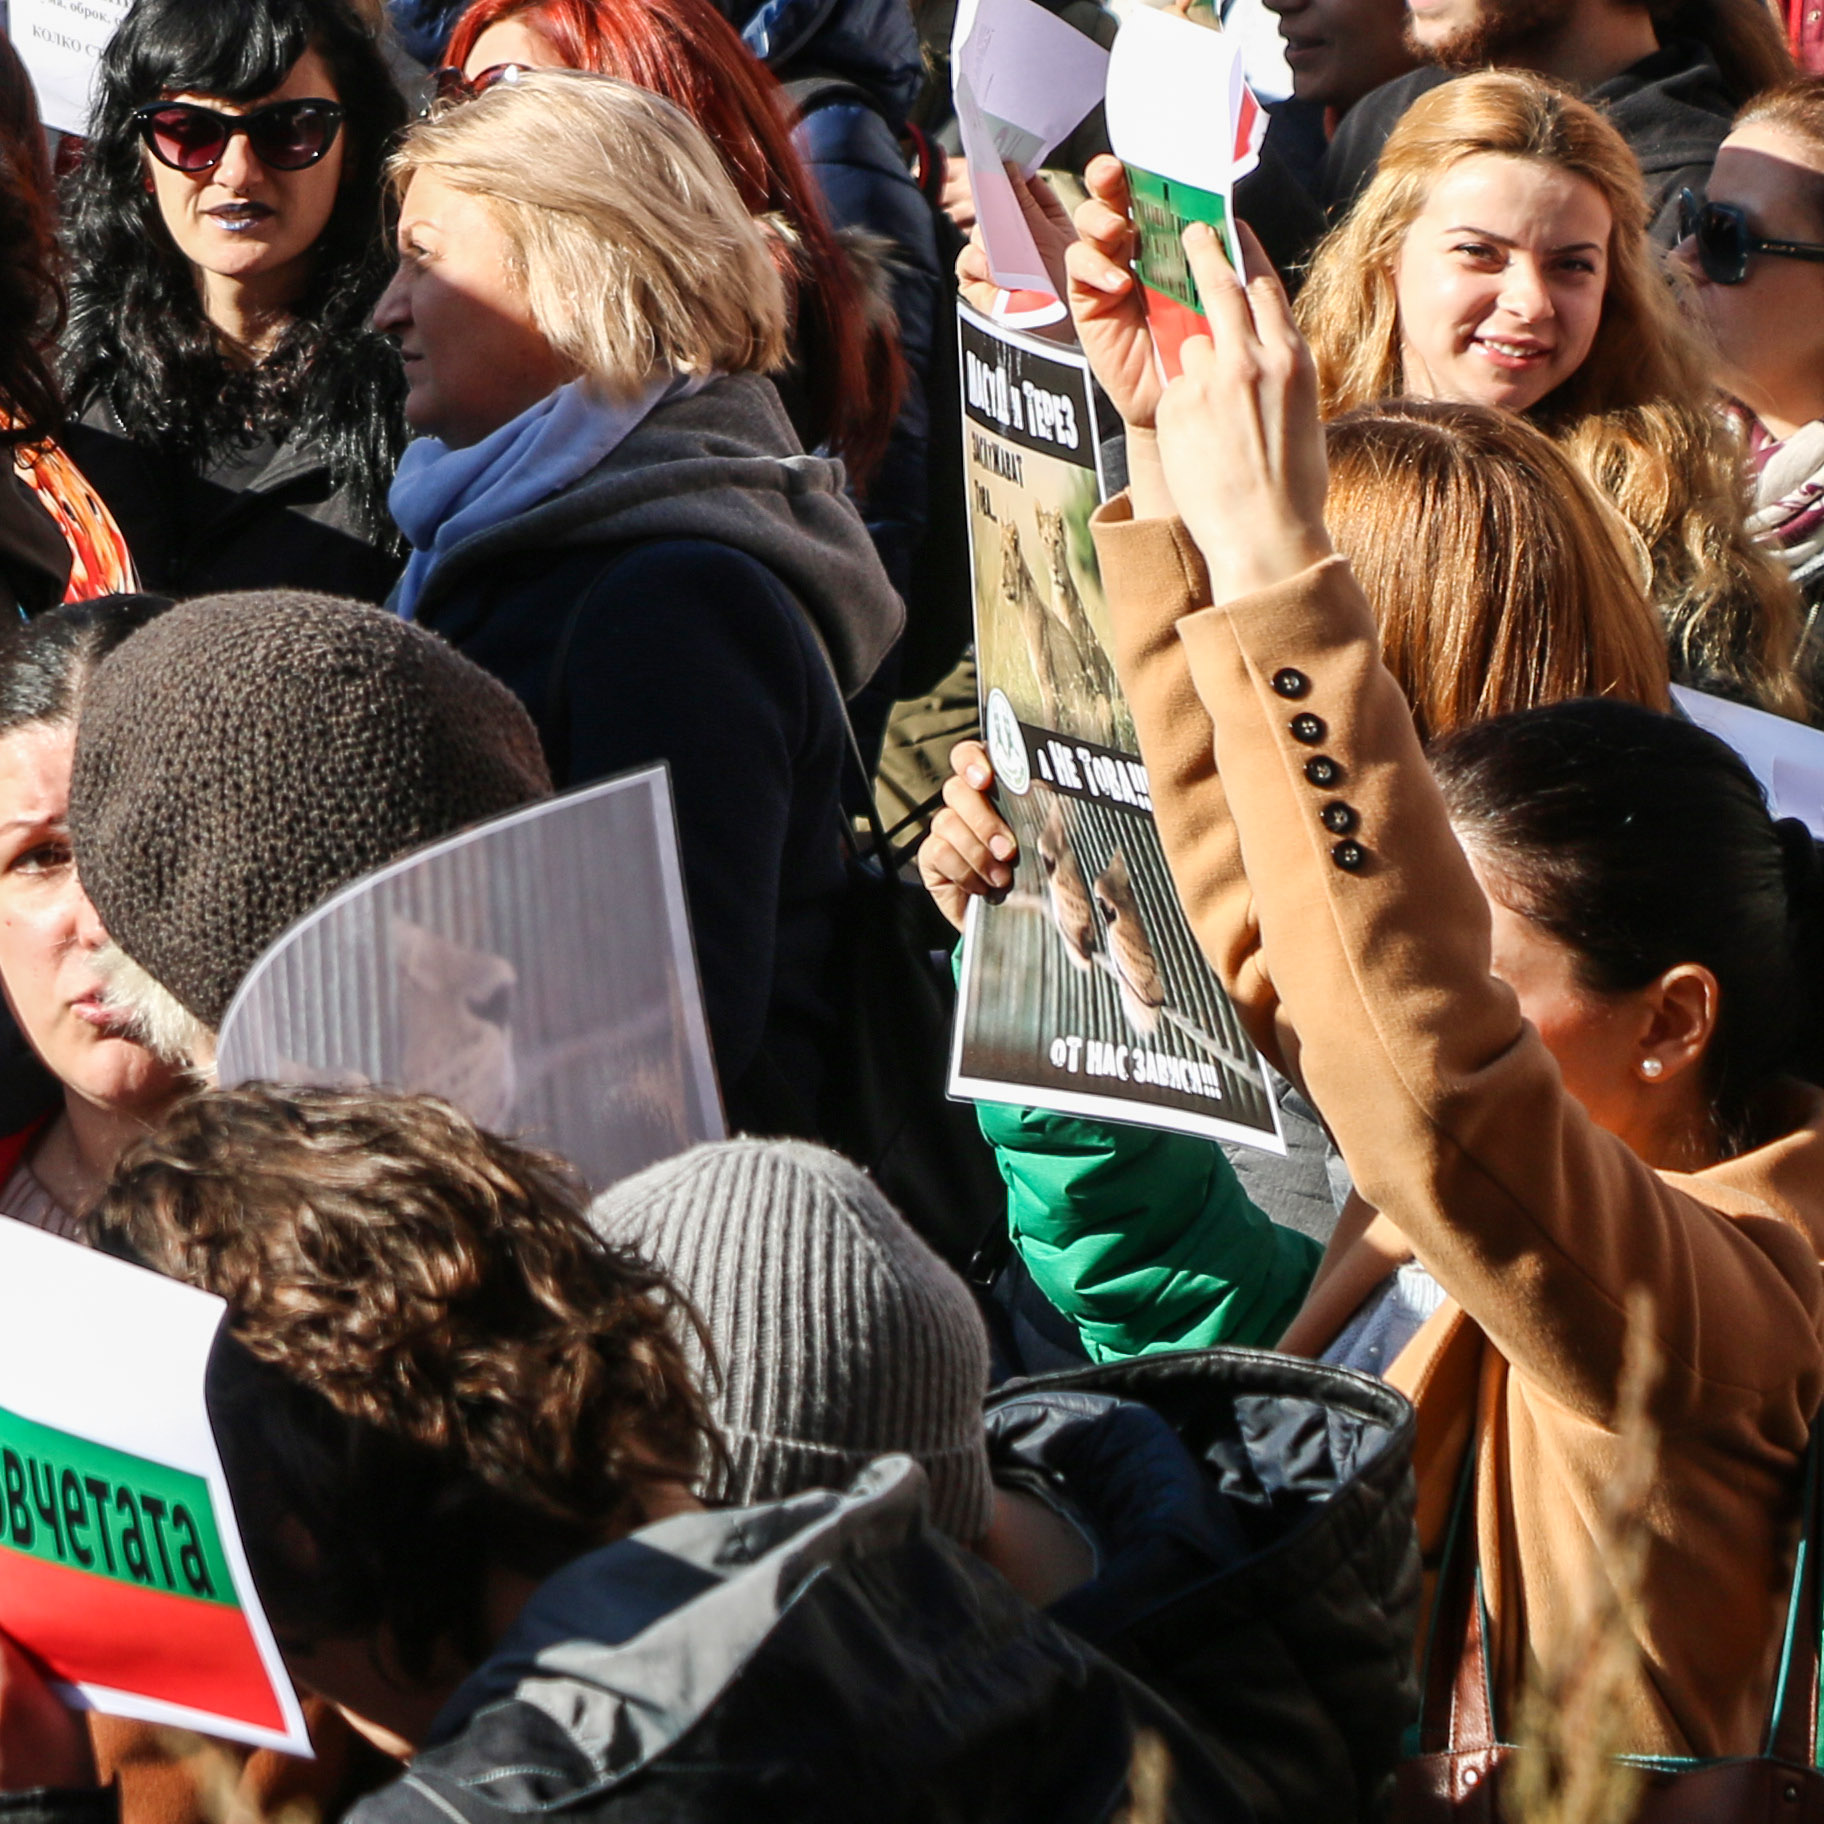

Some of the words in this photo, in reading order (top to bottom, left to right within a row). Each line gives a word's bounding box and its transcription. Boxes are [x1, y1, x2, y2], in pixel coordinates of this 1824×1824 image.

[70, 1, 112, 26] оброк,
[32, 24, 82, 54] КОЛКО
[1021, 379, 1079, 451] ТЕРЕЗ
[1046, 739, 1083, 790] НЕ
[1049, 1034, 1082, 1074] ОТ
[1084, 1039, 1130, 1082] НАС
